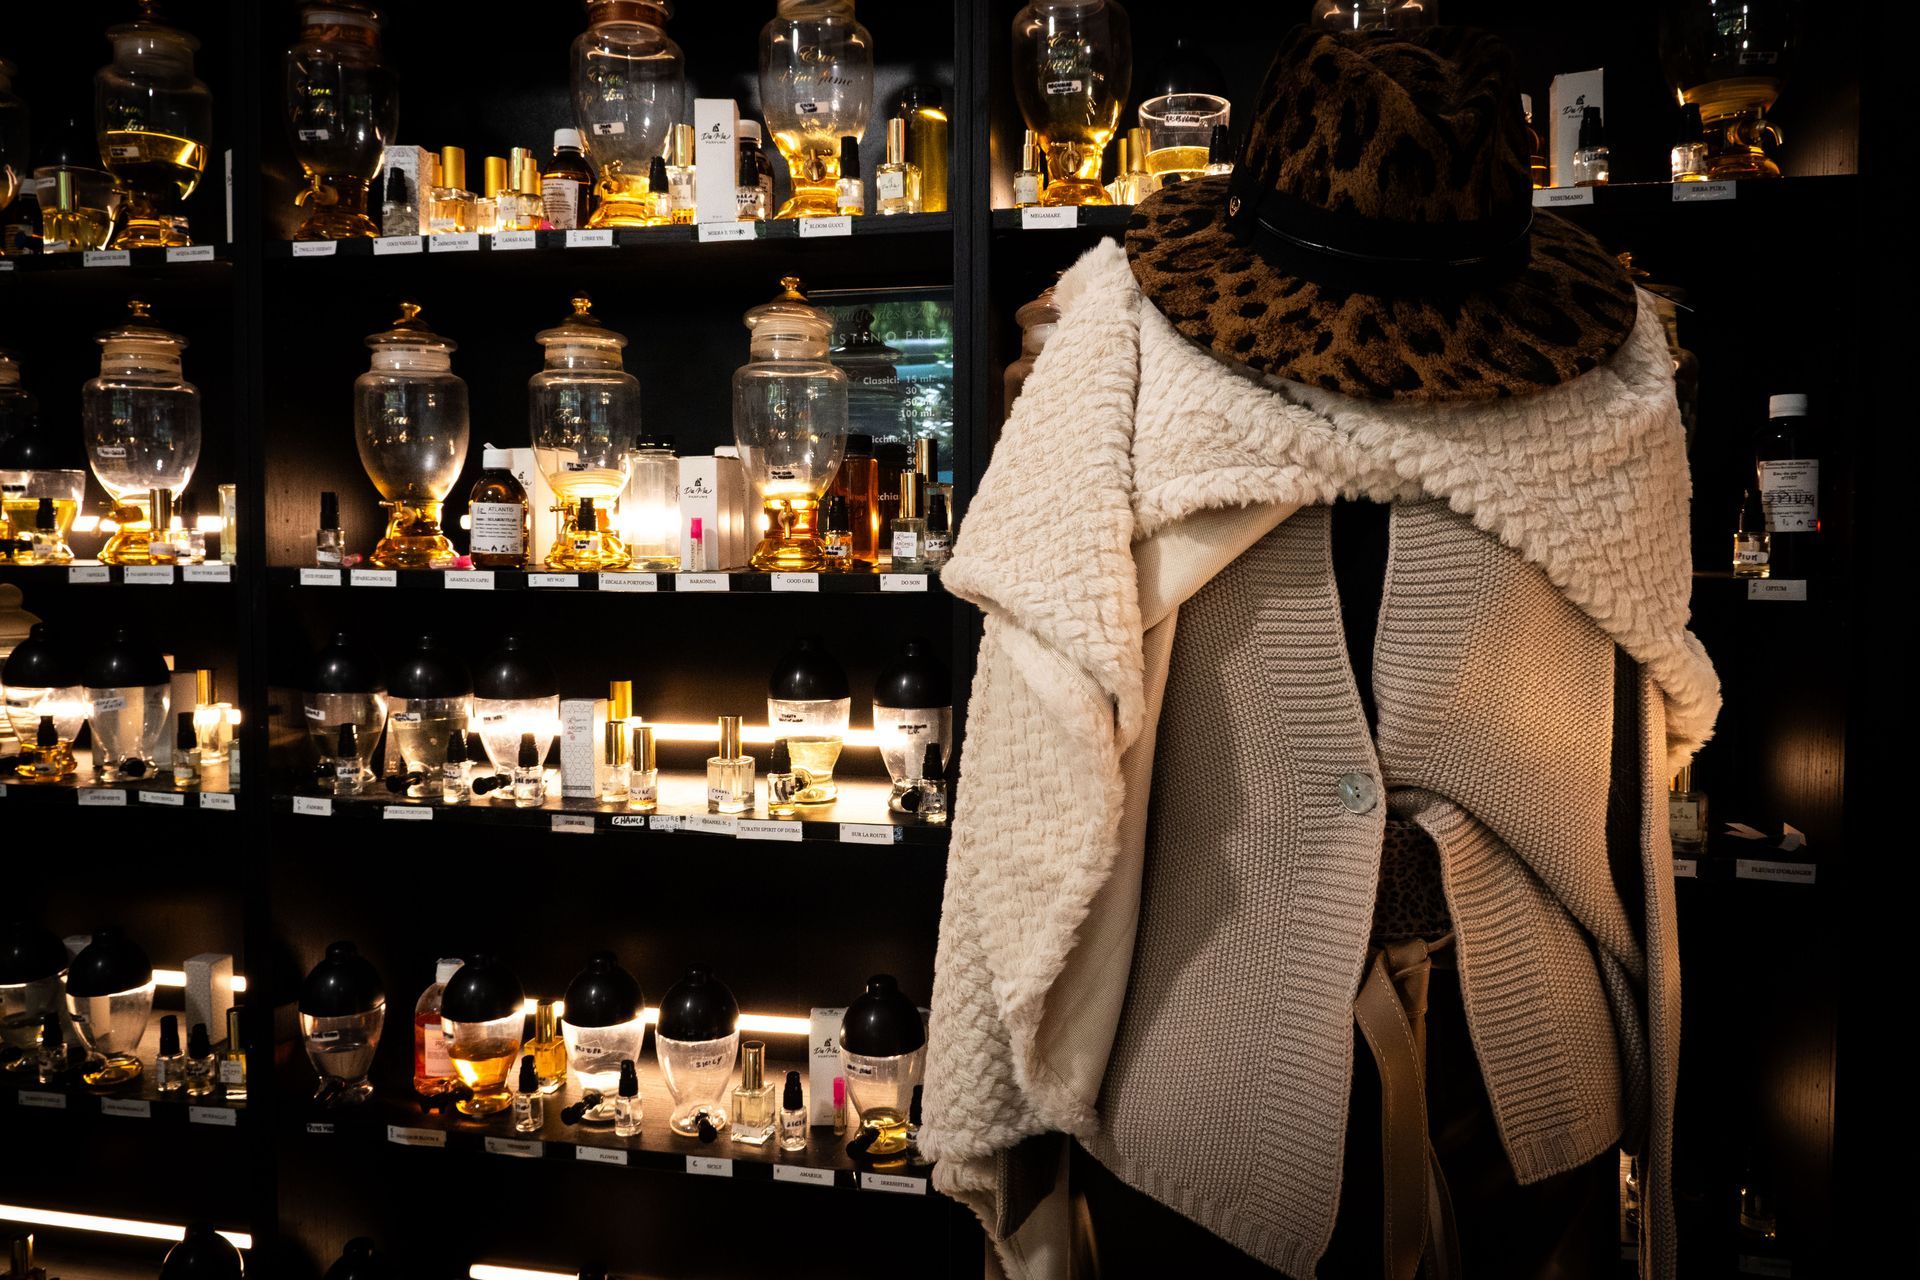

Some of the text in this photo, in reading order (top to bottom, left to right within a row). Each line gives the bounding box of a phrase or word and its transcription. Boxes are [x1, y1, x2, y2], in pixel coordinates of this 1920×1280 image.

[831, 329, 948, 345] ISTINO PREZ
[863, 376, 900, 385] Classici:
[905, 387, 917, 395] 30
[901, 410, 917, 418] 100
[871, 435, 901, 444] icchia:
[613, 815, 643, 825] CHANCE
